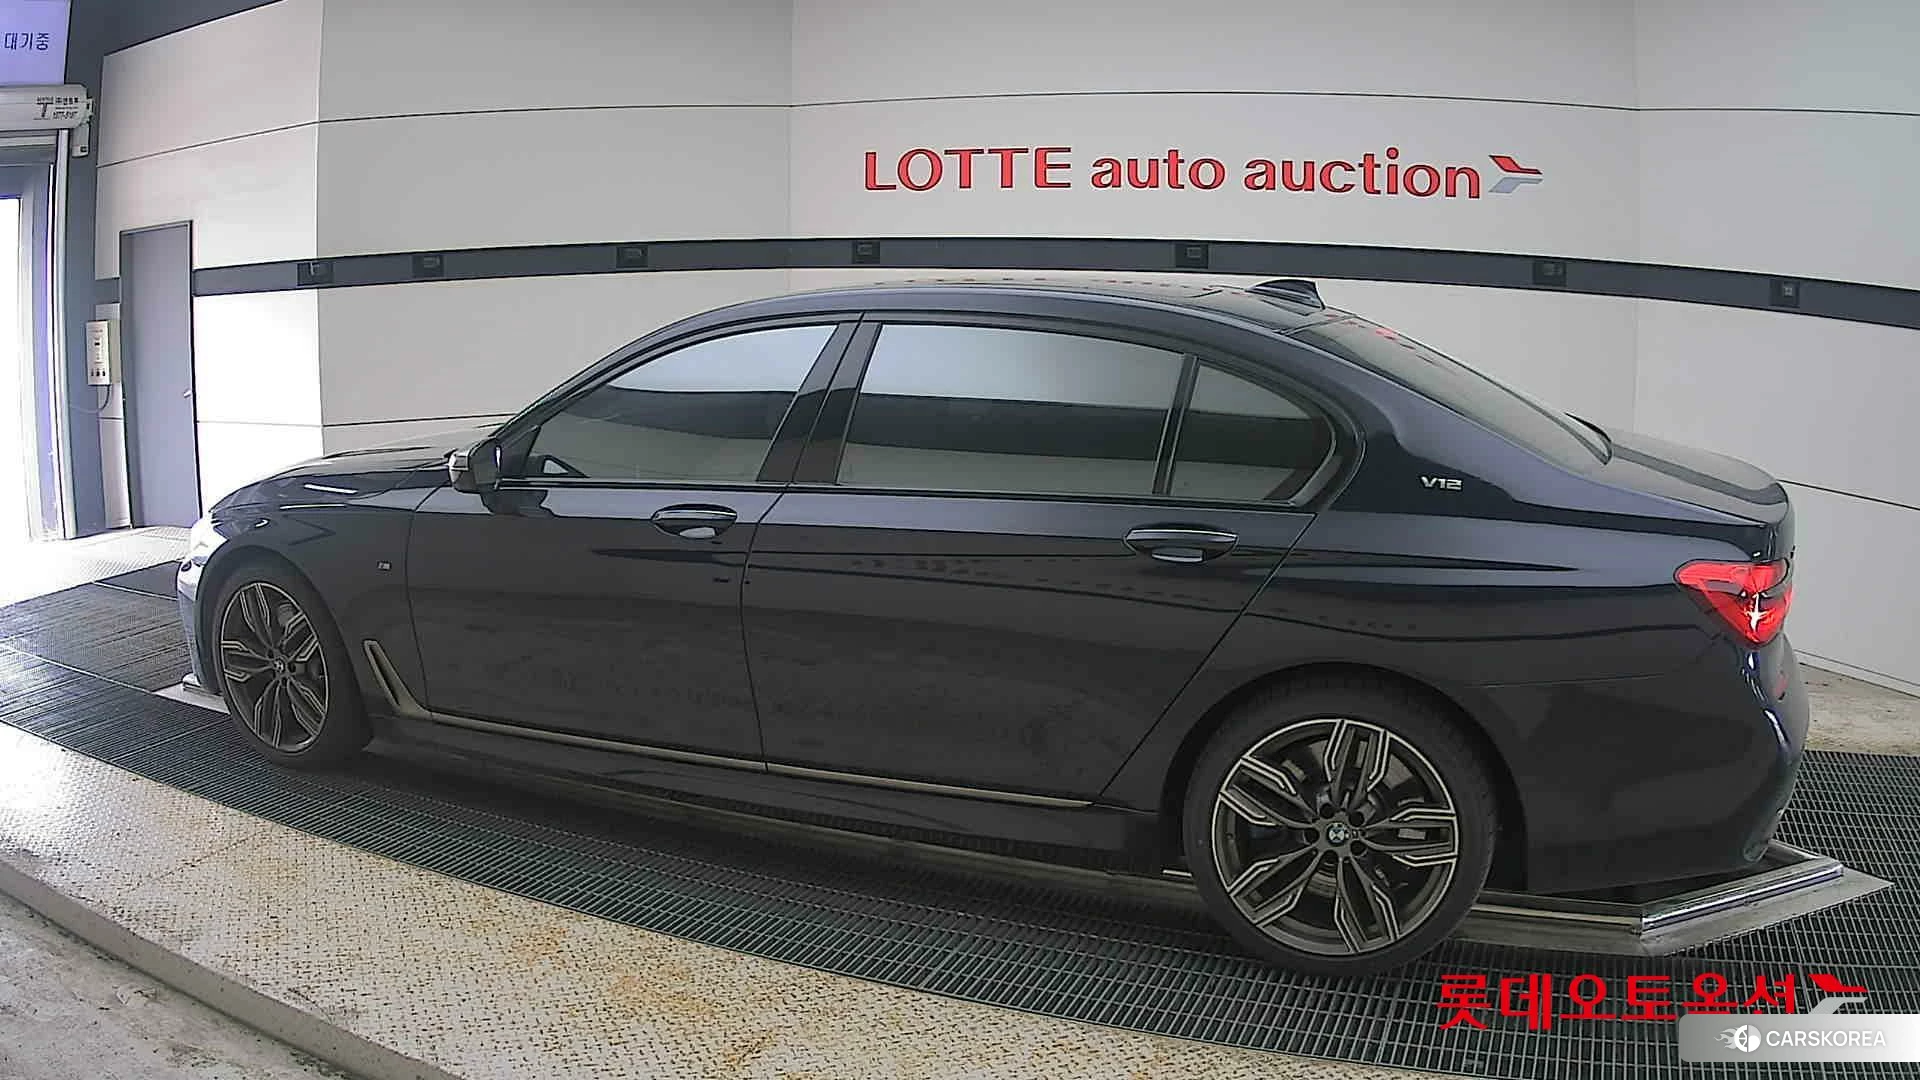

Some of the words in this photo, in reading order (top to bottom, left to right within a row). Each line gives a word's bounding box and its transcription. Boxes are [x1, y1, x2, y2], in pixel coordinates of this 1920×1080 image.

[4, 32, 49, 51] 대기중
[864, 146, 1072, 192] LOTTE
[1090, 148, 1226, 190] auto
[1243, 146, 1481, 199] auction
[1421, 476, 1462, 490] V12
